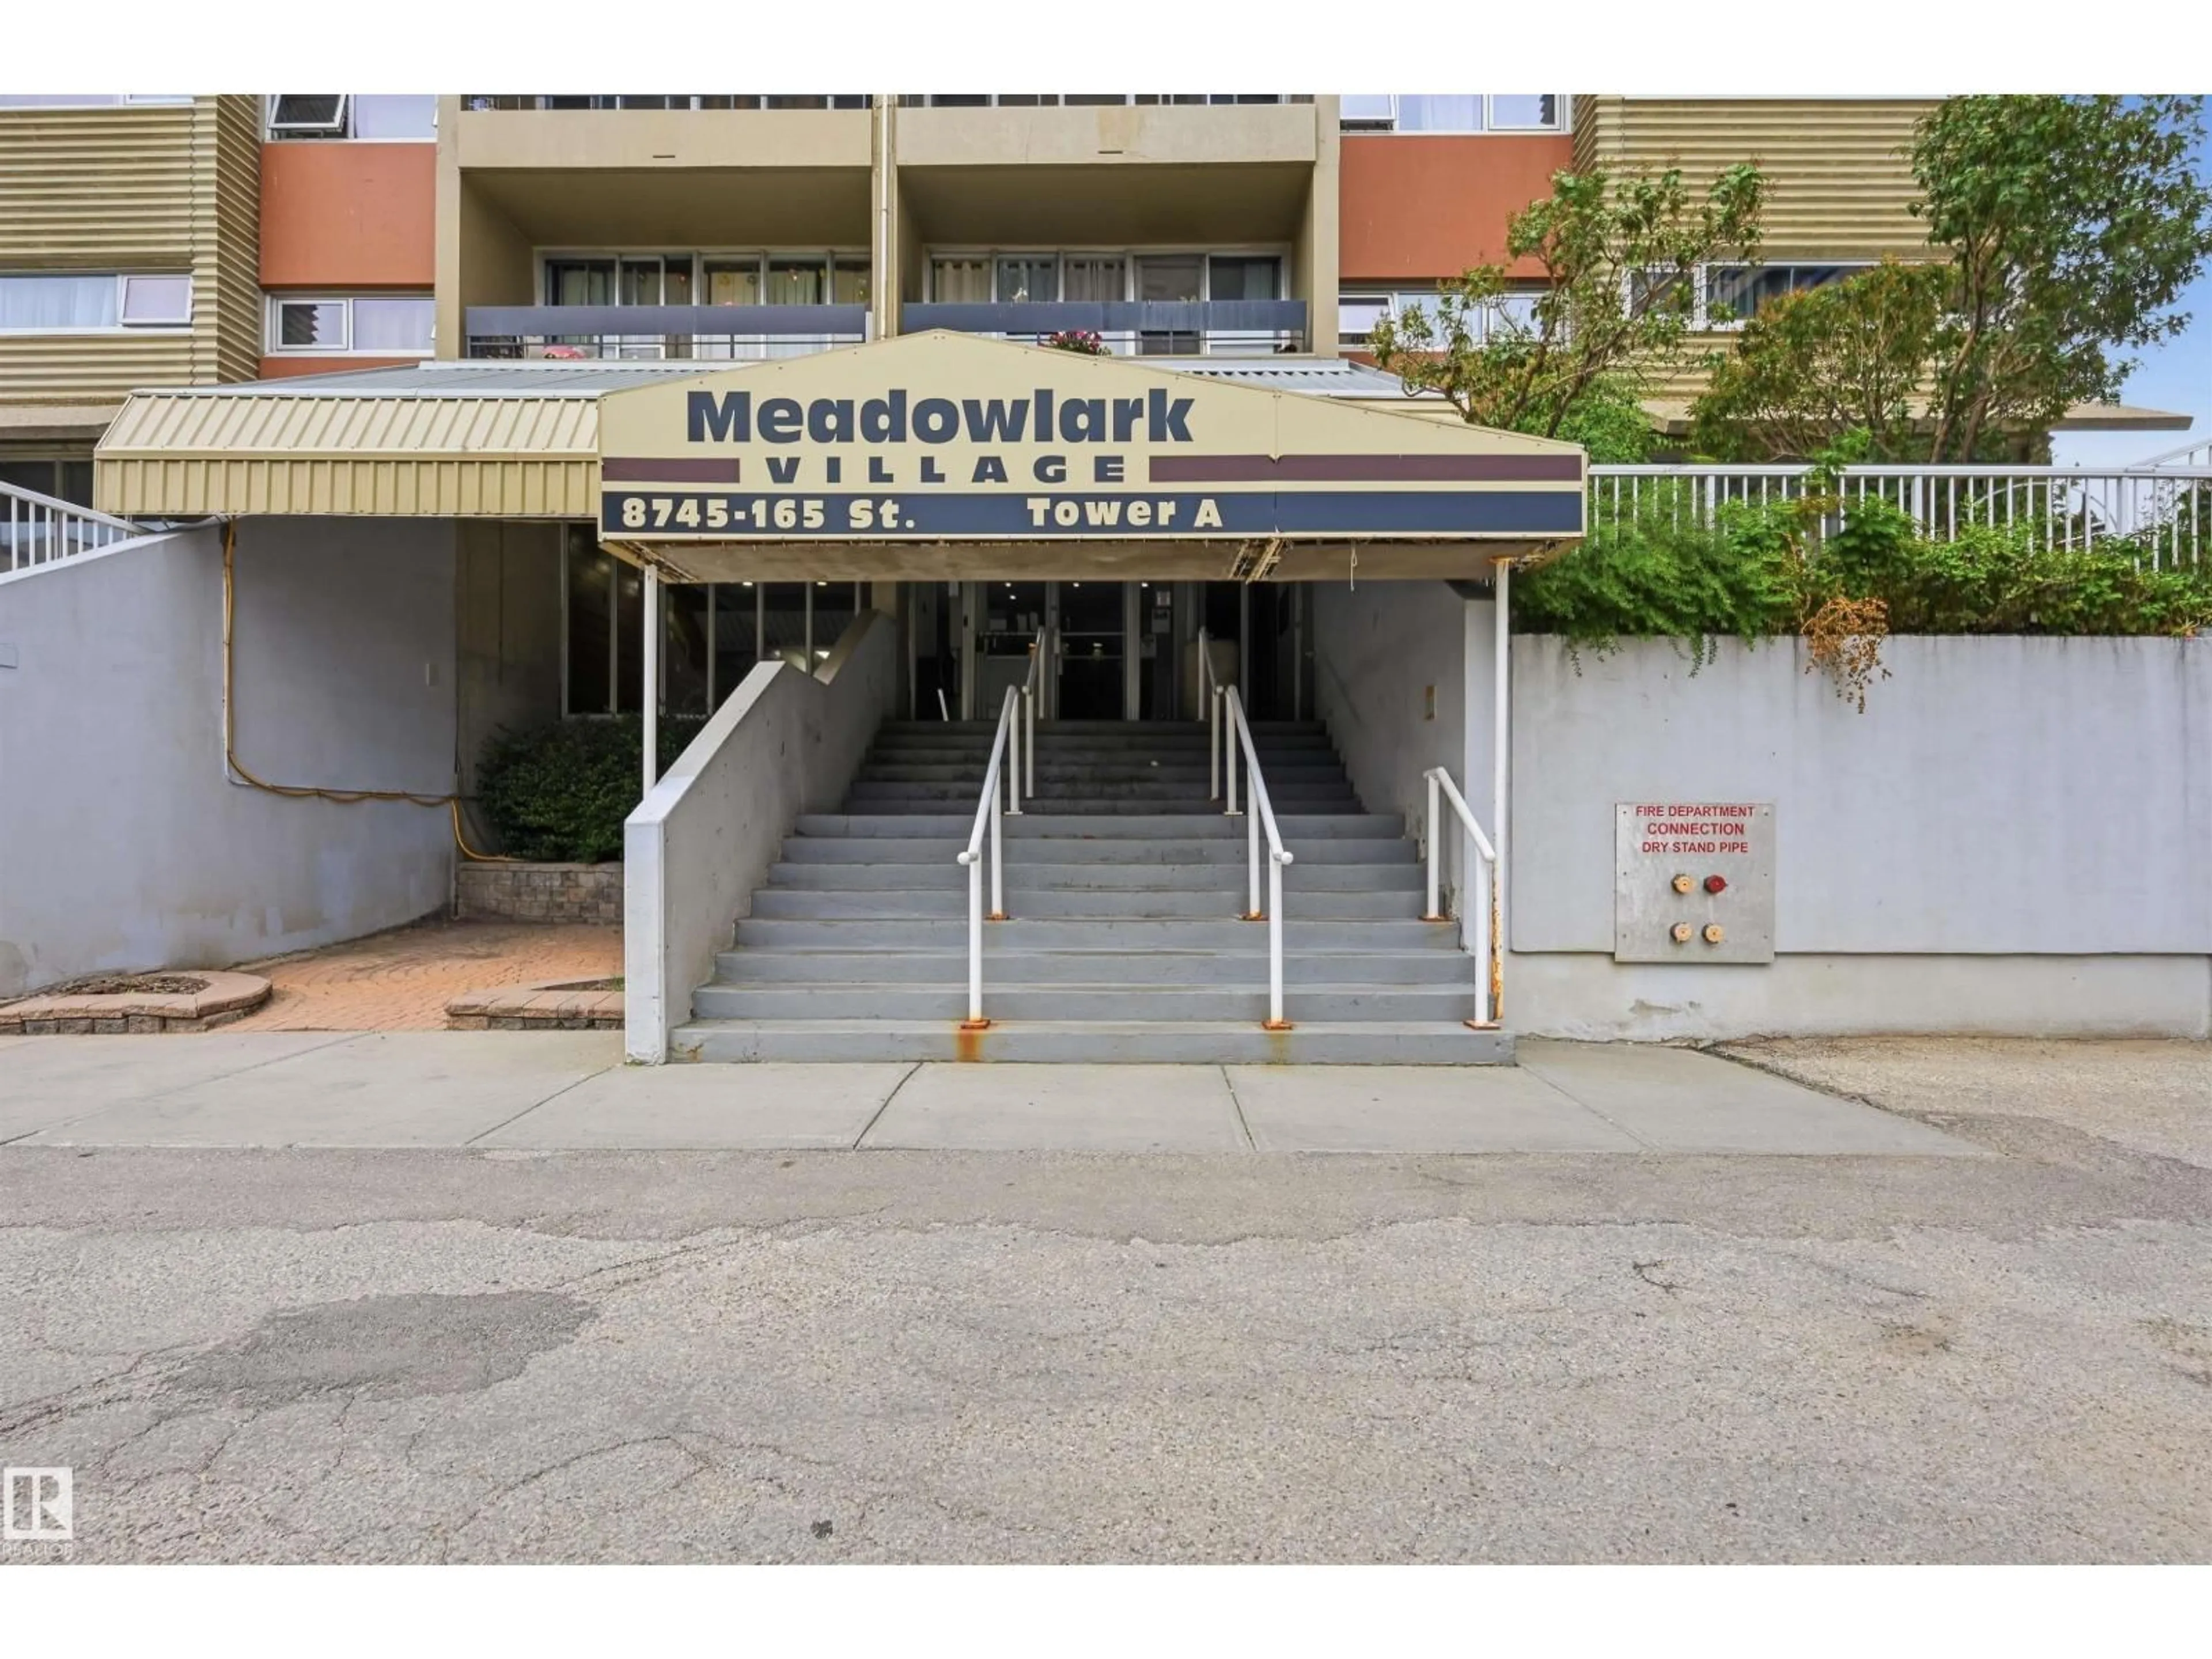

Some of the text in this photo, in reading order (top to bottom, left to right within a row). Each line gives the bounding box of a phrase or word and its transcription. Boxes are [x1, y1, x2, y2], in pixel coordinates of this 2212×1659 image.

[687, 388, 1194, 444] Meadowlark
[766, 455, 1124, 483] VILLAGE
[622, 498, 1223, 529] 8745-165 St. Tower A
[1636, 805, 1753, 817] FIRE DEPARTMENT
[1647, 823, 1745, 835] CONNECTION
[1642, 842, 1748, 853] DRY STAND PIPE
